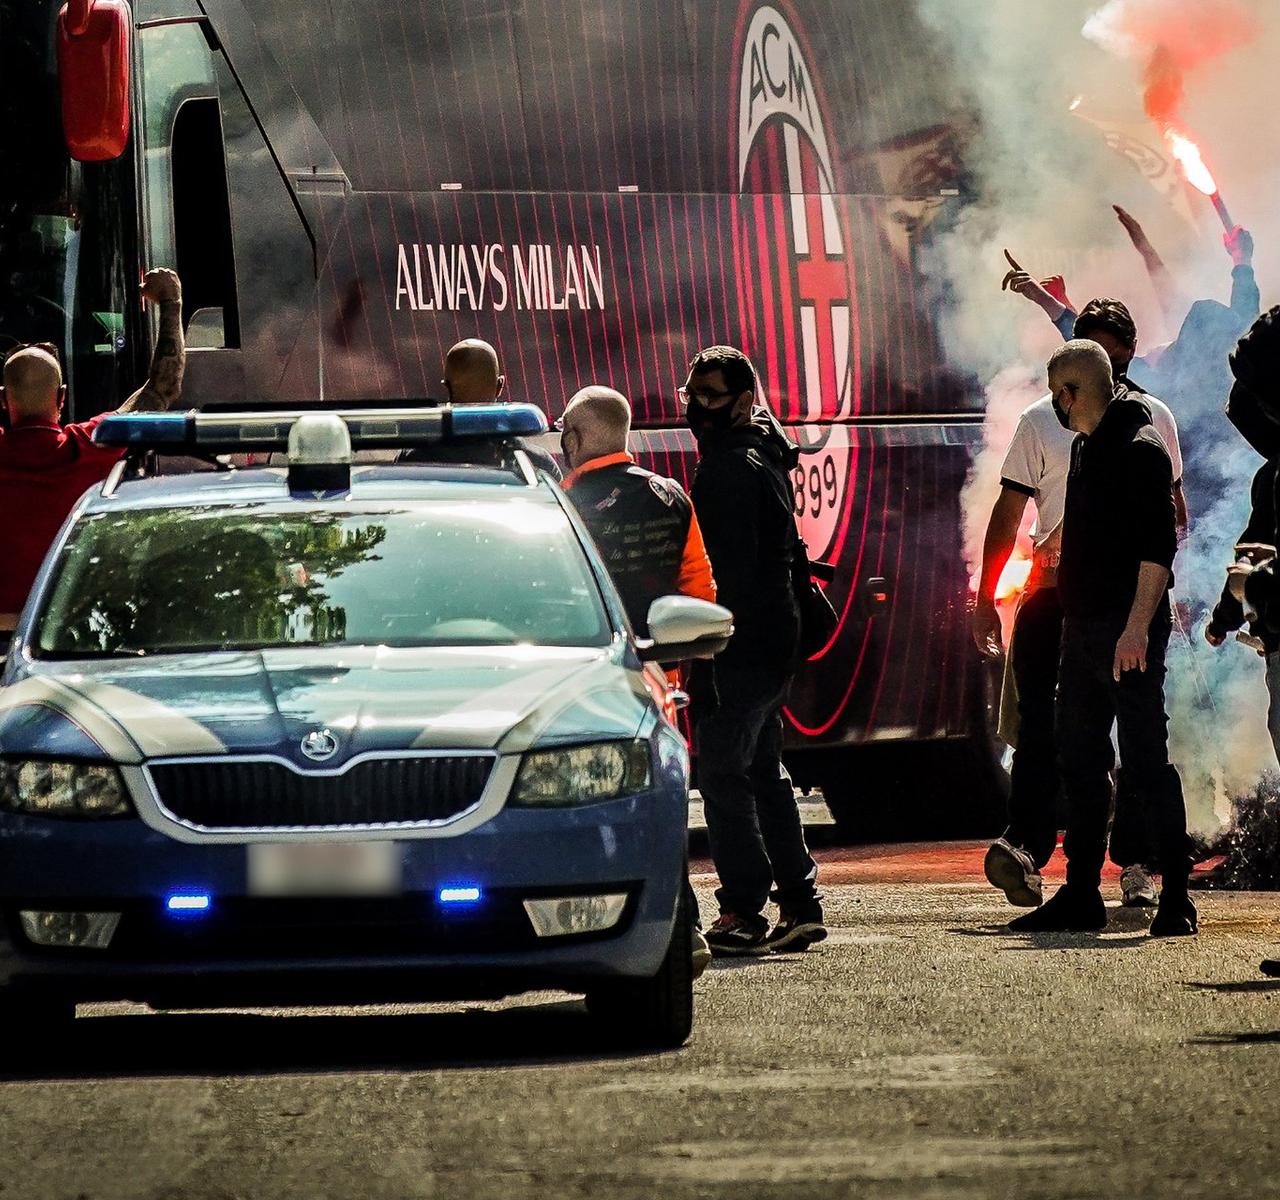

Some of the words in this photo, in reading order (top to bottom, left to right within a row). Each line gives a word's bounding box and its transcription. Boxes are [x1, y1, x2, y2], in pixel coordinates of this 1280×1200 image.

[747, 22, 815, 133] ACM
[395, 243, 508, 312] ALWAYS
[511, 244, 605, 311] MILAN
[790, 454, 837, 519] 899
